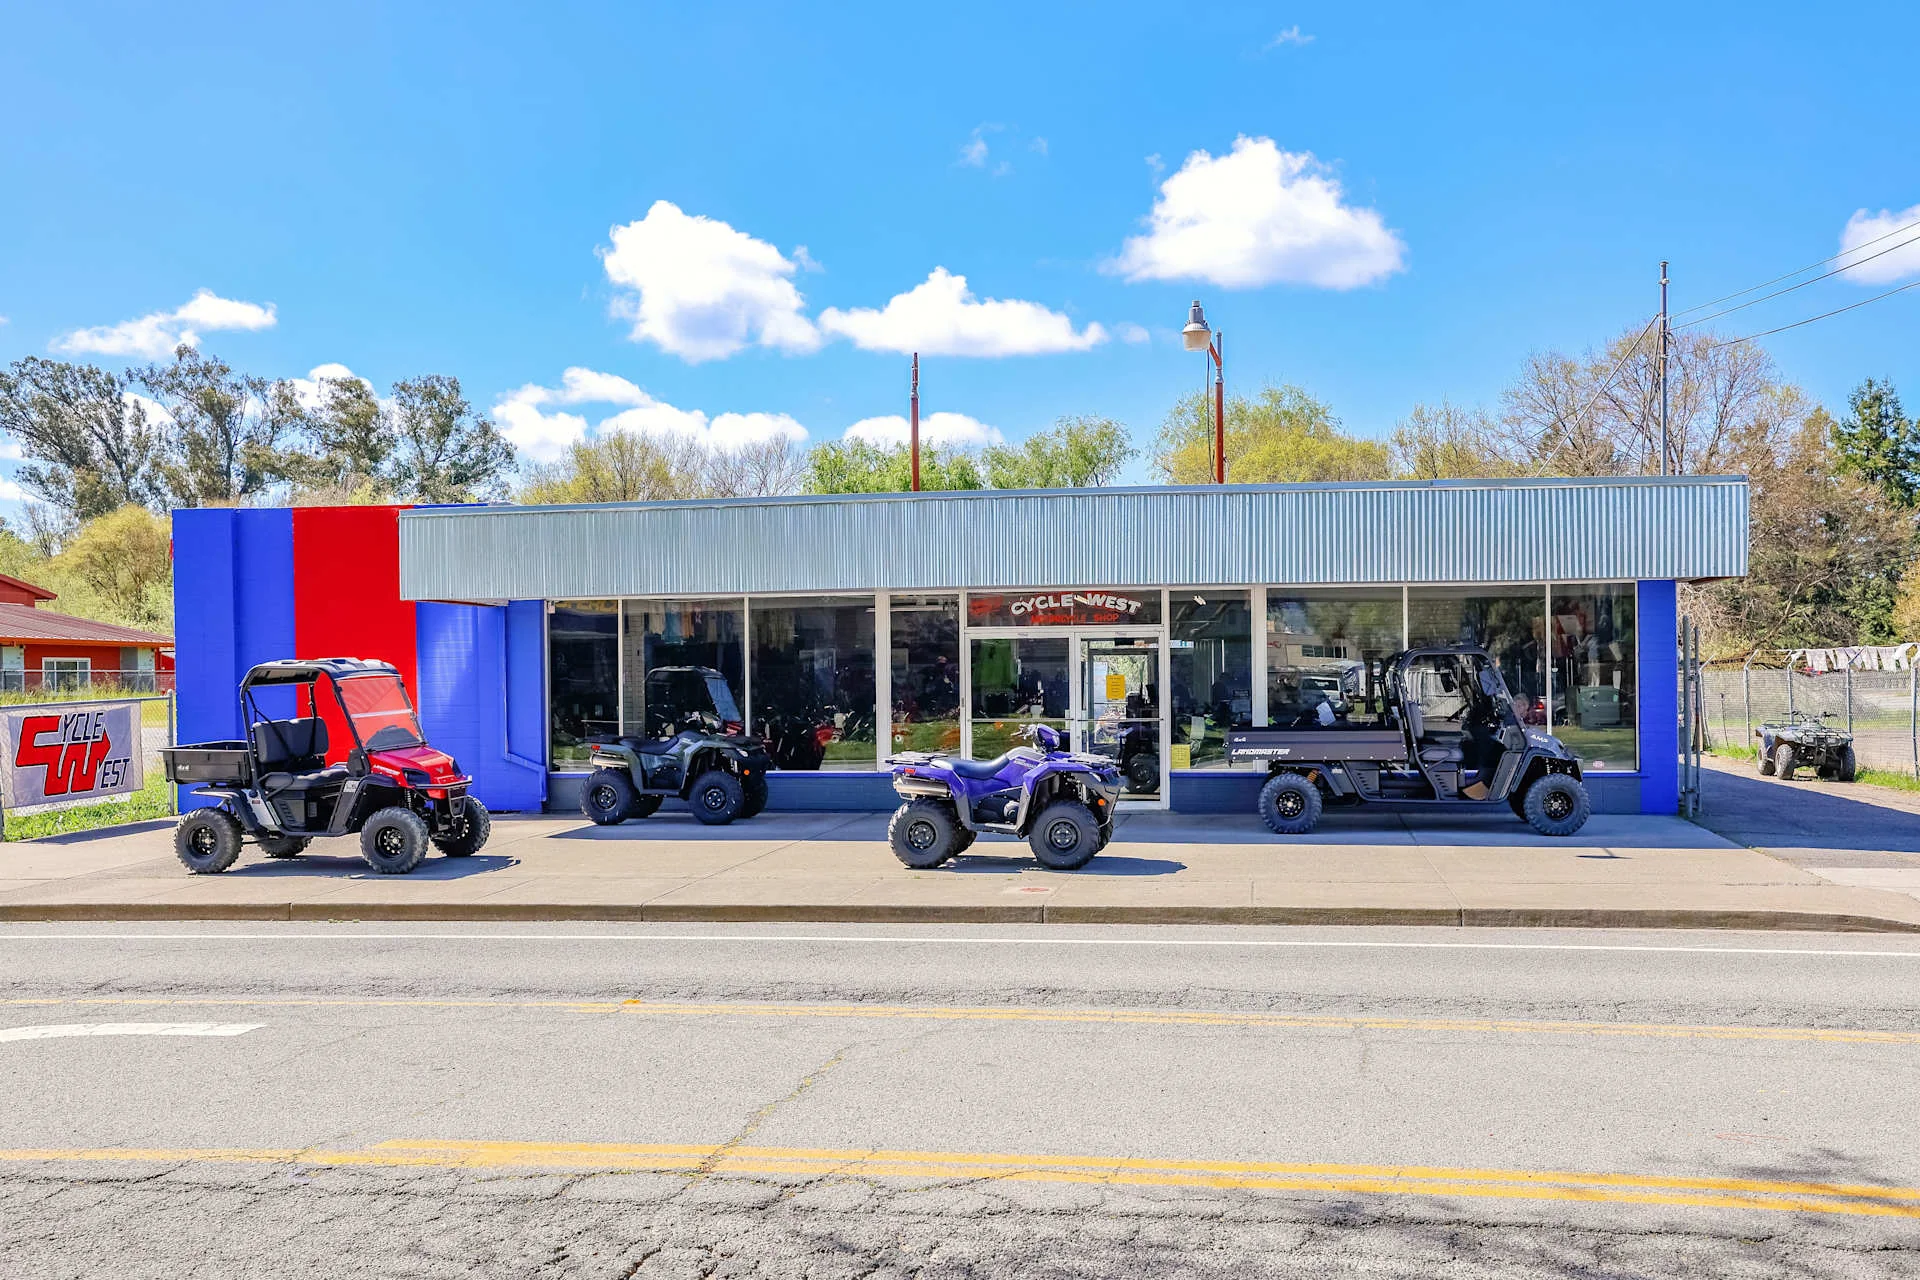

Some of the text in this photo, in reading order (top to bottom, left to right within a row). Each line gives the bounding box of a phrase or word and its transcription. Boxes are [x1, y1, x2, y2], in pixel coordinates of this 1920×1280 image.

[1010, 594, 1074, 615] CYCLE
[1086, 593, 1142, 614] WEST
[1094, 613, 1120, 623] SHOP
